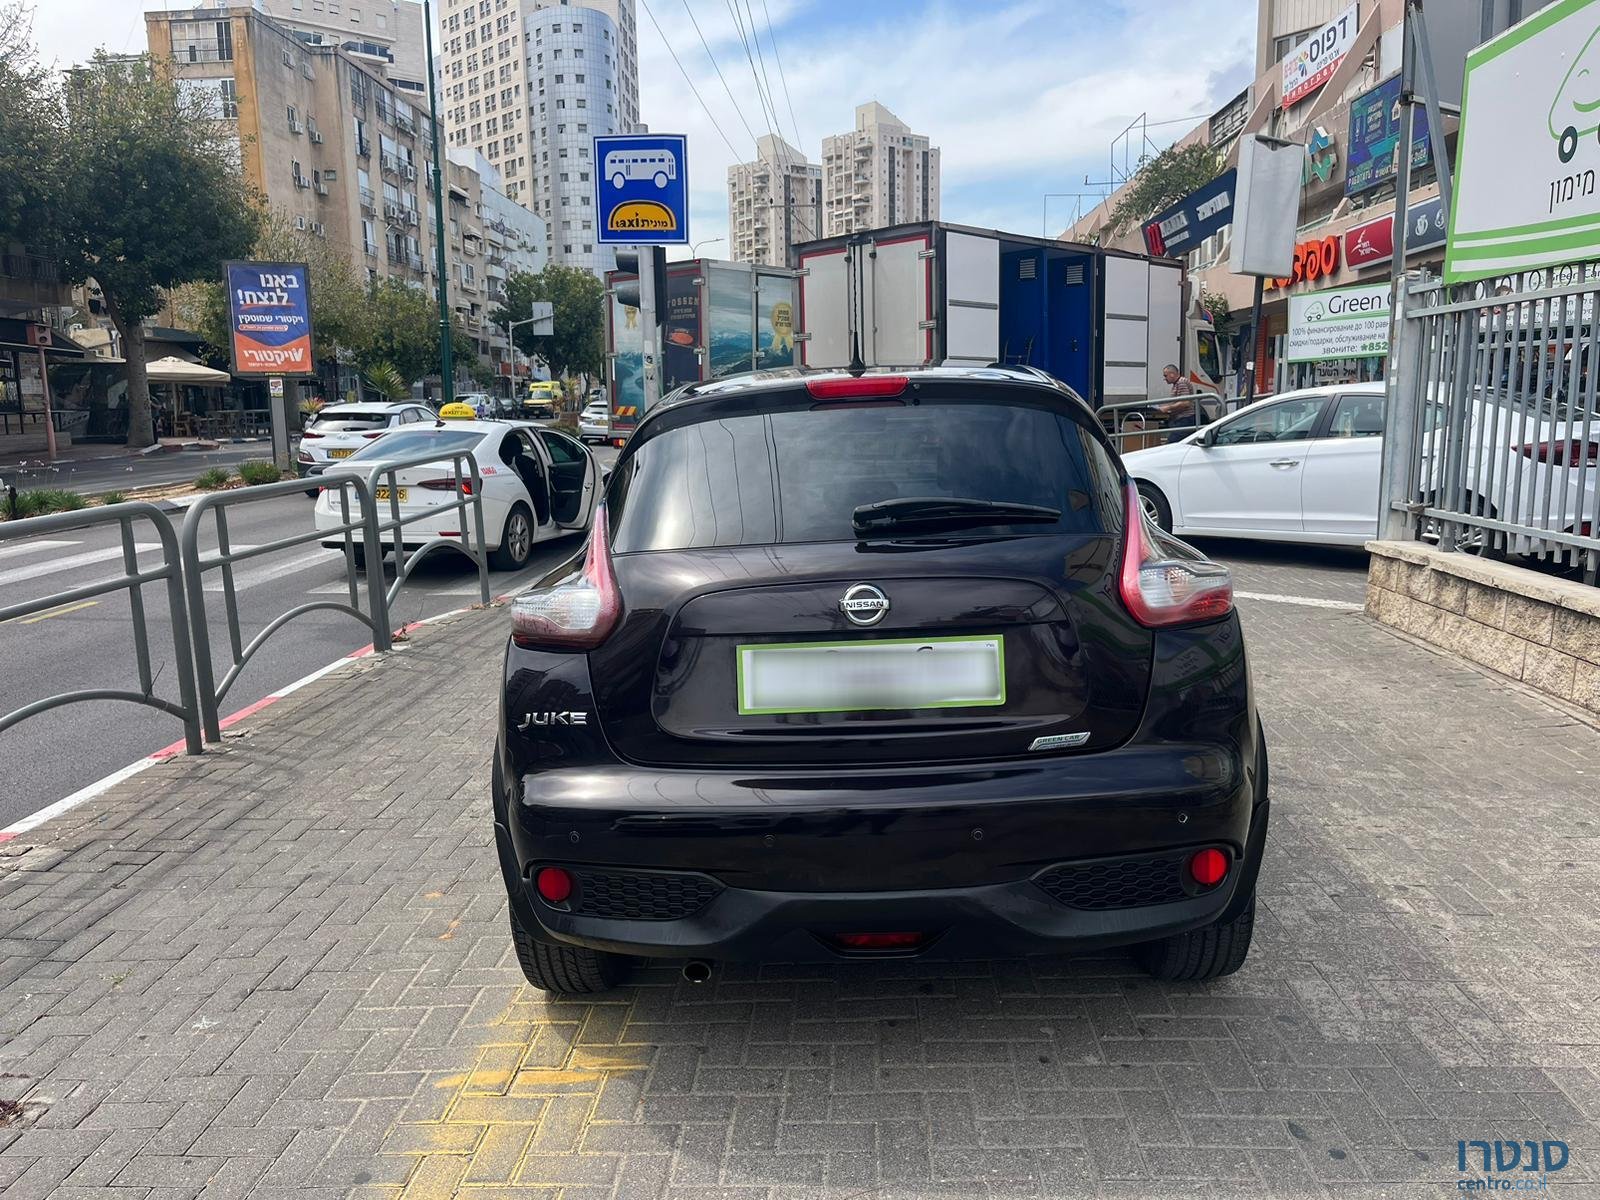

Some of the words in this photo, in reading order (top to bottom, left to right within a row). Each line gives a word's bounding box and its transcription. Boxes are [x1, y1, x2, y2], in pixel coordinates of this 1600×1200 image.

[1309, 15, 1348, 63] דפוס
[1549, 169, 1595, 214] מימון
[616, 211, 640, 228] taxi
[640, 218, 668, 228] מונית
[259, 273, 299, 288] באנו
[237, 288, 290, 305] לנצח!
[1328, 294, 1382, 315] Green
[275, 315, 304, 326] ויקטורי
[1364, 321, 1375, 329] 100
[845, 600, 884, 608] NISSAN
[517, 711, 588, 731] JUKE
[1037, 736, 1063, 744] GREEN
